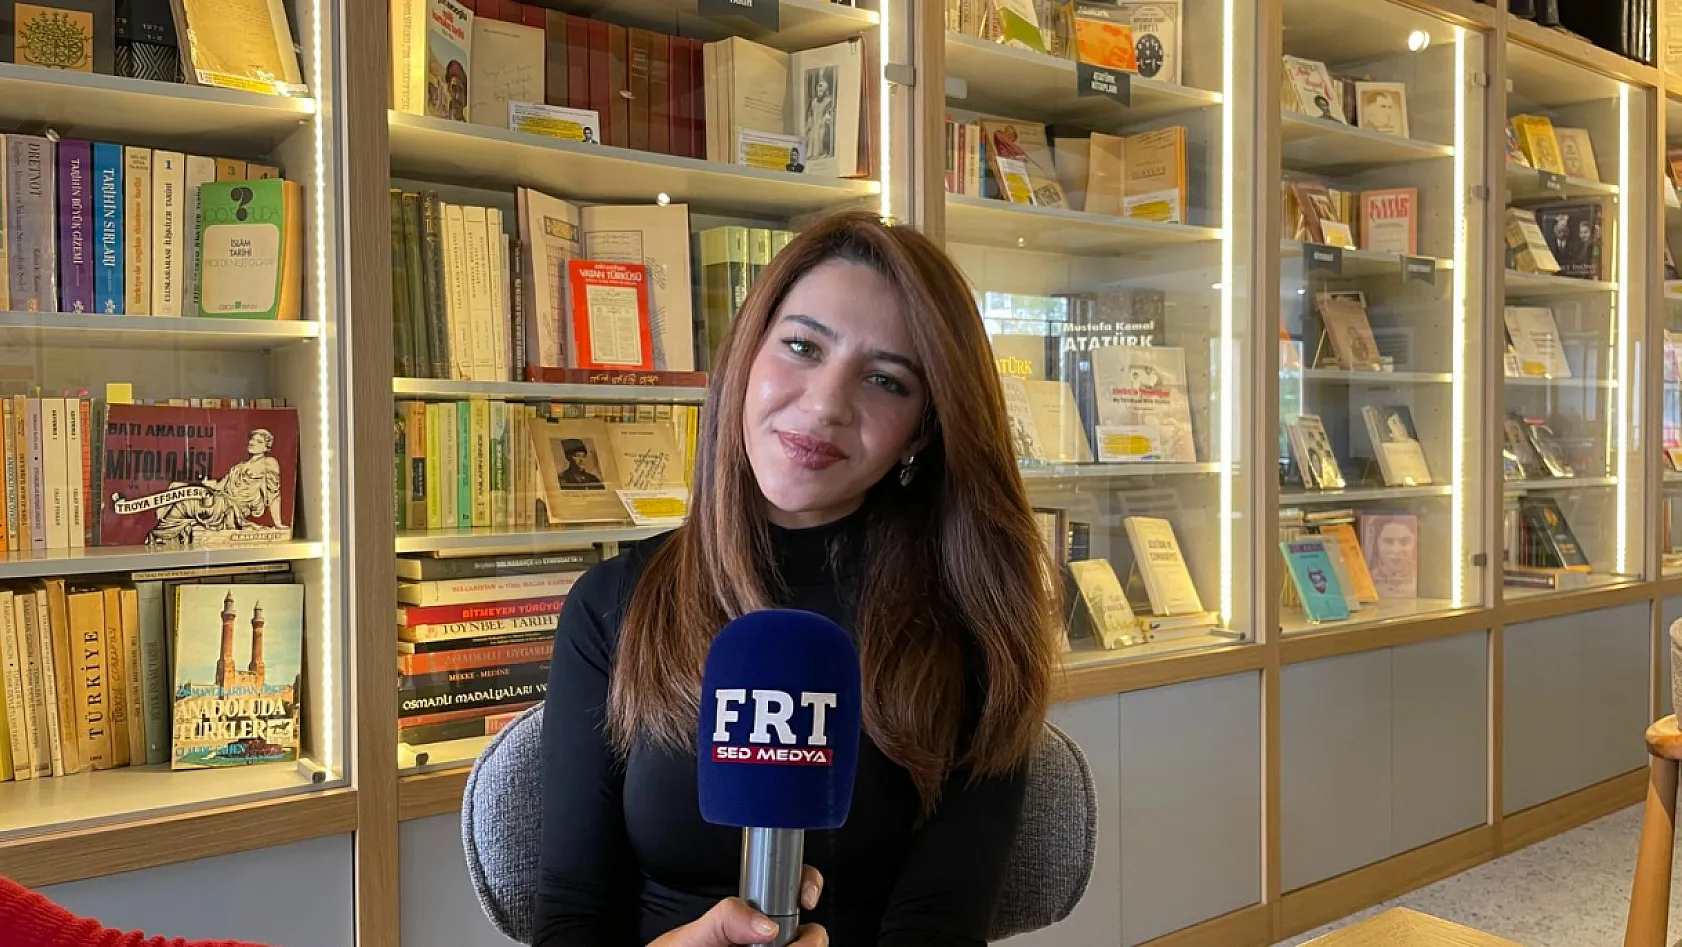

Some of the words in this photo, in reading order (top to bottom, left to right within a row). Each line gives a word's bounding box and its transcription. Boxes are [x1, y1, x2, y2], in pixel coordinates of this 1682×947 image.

[102, 167, 114, 218] TARİHİN
[579, 268, 605, 279] VATAN
[1063, 321, 1112, 332] Mustafa
[1115, 320, 1155, 331] Kemal
[1064, 332, 1154, 352] ATATÜRK
[996, 355, 1034, 376] TÜRK
[108, 422, 141, 437] BATI
[145, 423, 214, 439] ANADOLU
[105, 444, 214, 481] MİTOLOJİSİ
[116, 501, 150, 513] TROYA
[153, 488, 202, 505] EFSANES
[462, 605, 516, 618] BİTMEYEN
[442, 619, 506, 635] TOYNBEE
[80, 630, 105, 741] TÜRKİYE
[448, 671, 474, 682] MEKKE
[175, 698, 287, 718] ANADOLUDA
[402, 693, 453, 711] OSMANLI
[455, 685, 533, 704] MADALYALARI
[712, 688, 838, 746] FRT
[174, 718, 268, 741] TÜRKLER
[716, 746, 752, 760] SED
[756, 747, 827, 763] MEDYA
